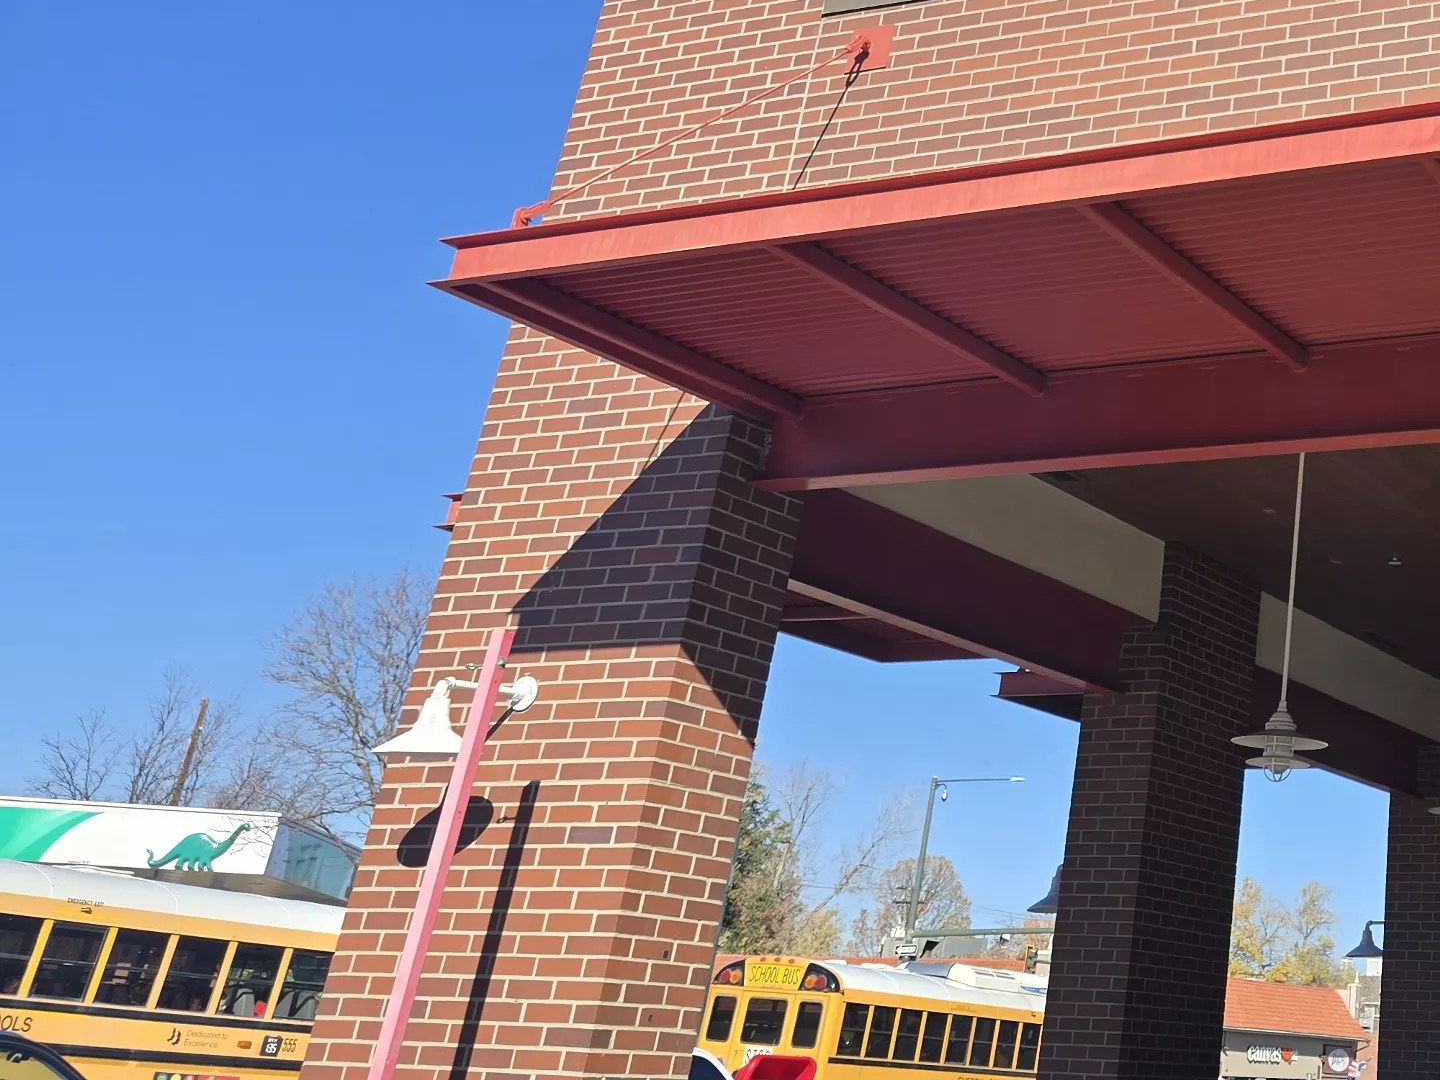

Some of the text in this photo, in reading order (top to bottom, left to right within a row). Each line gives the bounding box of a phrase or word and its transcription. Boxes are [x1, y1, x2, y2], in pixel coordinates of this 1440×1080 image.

[749, 965, 800, 985] SCHOOL BUS
[0, 1014, 33, 1032] OLS
[186, 1029, 229, 1040] Dedicated to
[183, 1039, 219, 1049] Excellence
[282, 1038, 298, 1053] 555
